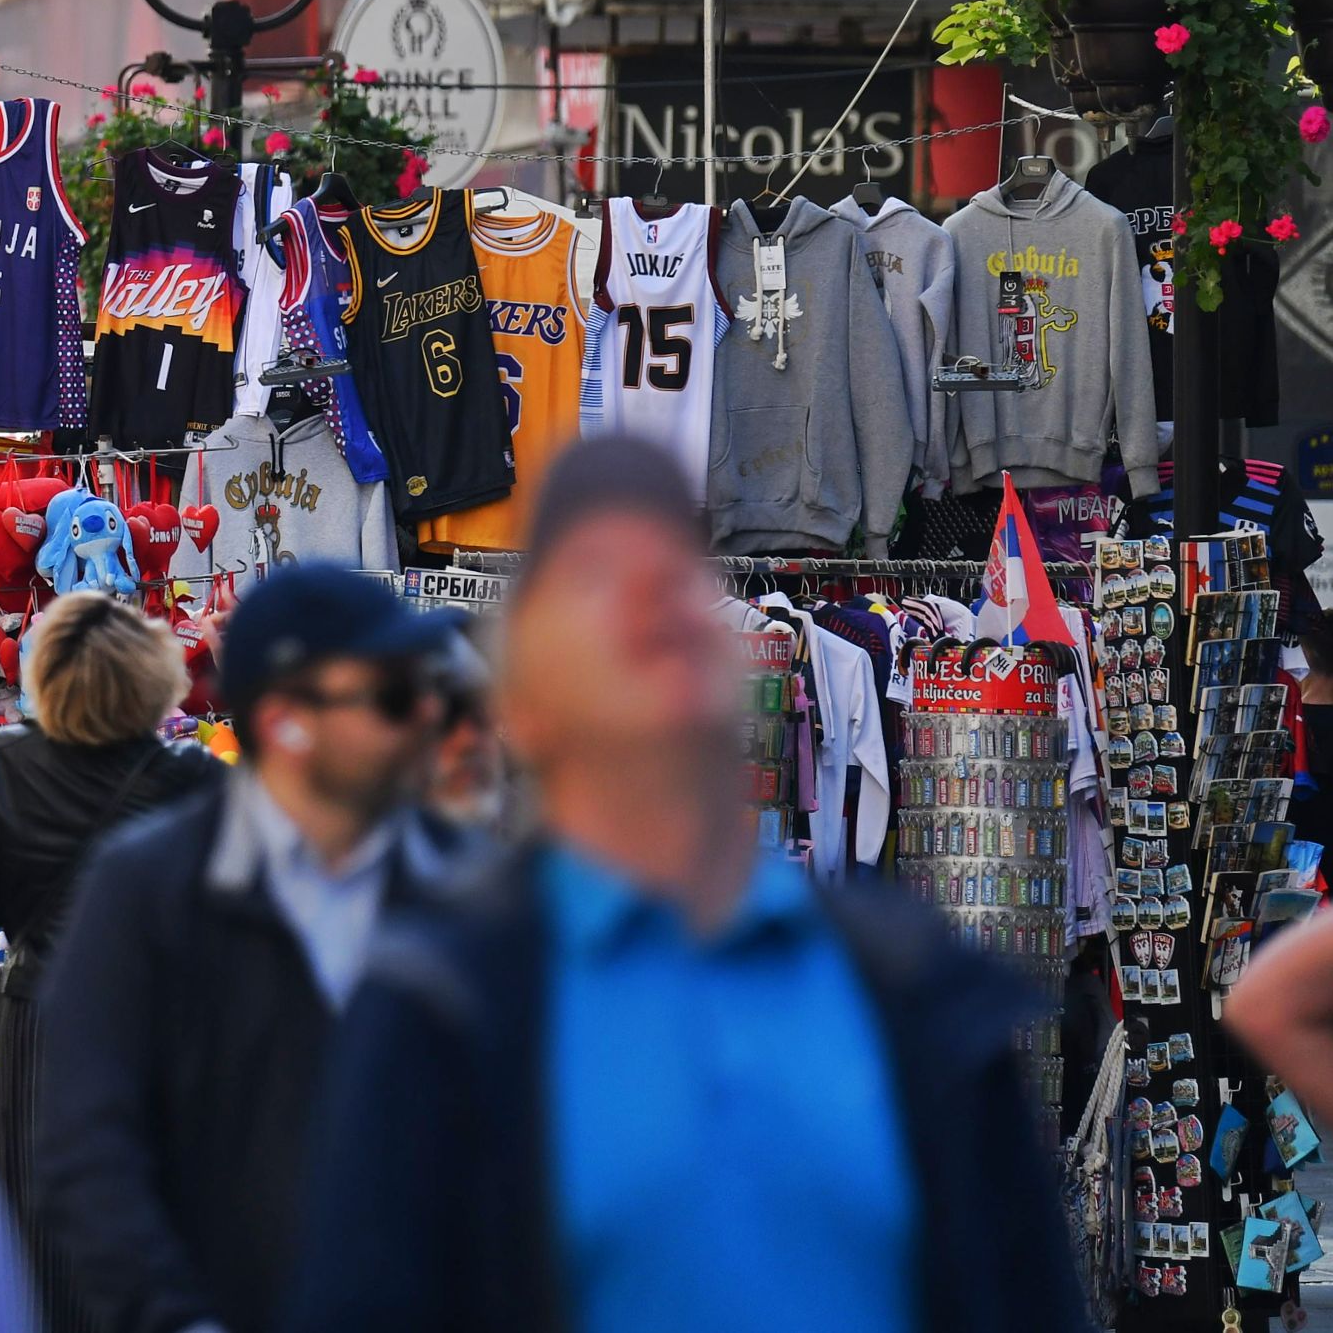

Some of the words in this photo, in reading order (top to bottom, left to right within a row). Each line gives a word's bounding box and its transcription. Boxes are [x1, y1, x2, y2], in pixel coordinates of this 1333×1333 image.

[382, 69, 476, 92] RINCE
[128, 269, 154, 281] THE
[626, 252, 685, 278] JOKIĆ
[382, 275, 483, 343] LAKERS
[618, 303, 694, 391] 15
[157, 342, 174, 391] 1
[421, 328, 463, 398] 6
[424, 575, 502, 600] СРБИЈА
[923, 684, 982, 703] ključeve
[1025, 692, 1041, 703] za
